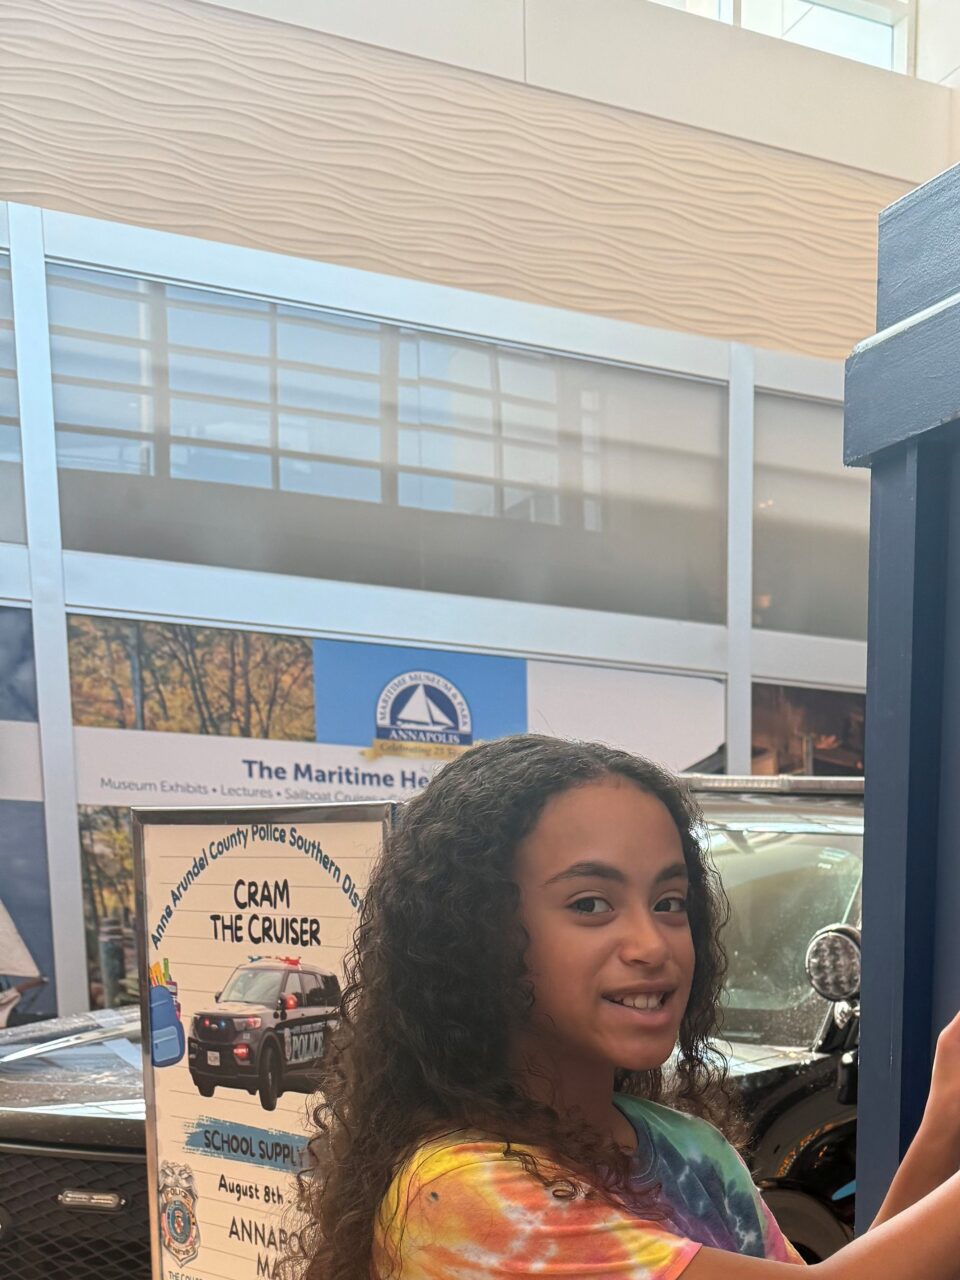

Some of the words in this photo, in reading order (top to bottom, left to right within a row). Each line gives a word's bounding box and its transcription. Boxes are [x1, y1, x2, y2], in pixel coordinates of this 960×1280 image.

[378, 677, 408, 721] MARITIME
[407, 673, 452, 692] MUSEUM
[389, 729, 460, 744] ANNAPOLIS
[100, 777, 157, 792] Museum
[160, 780, 208, 796] Exhibits
[220, 784, 273, 799] Lectures
[285, 787, 332, 801] Sailboat
[242, 759, 287, 780] The
[294, 763, 394, 788] Maritime
[150, 904, 174, 950] Anne
[171, 847, 209, 908] Arundel
[209, 827, 249, 861] County
[251, 824, 287, 844] Police
[289, 827, 342, 883] Southern
[233, 878, 291, 910] CRAM
[210, 914, 244, 943] THE
[248, 914, 322, 947] CRUISER
[203, 1130, 256, 1158] SCHOOL
[218, 1174, 260, 1201] August
[263, 1186, 284, 1205] 8th
[228, 1216, 301, 1255] ANNAPO
